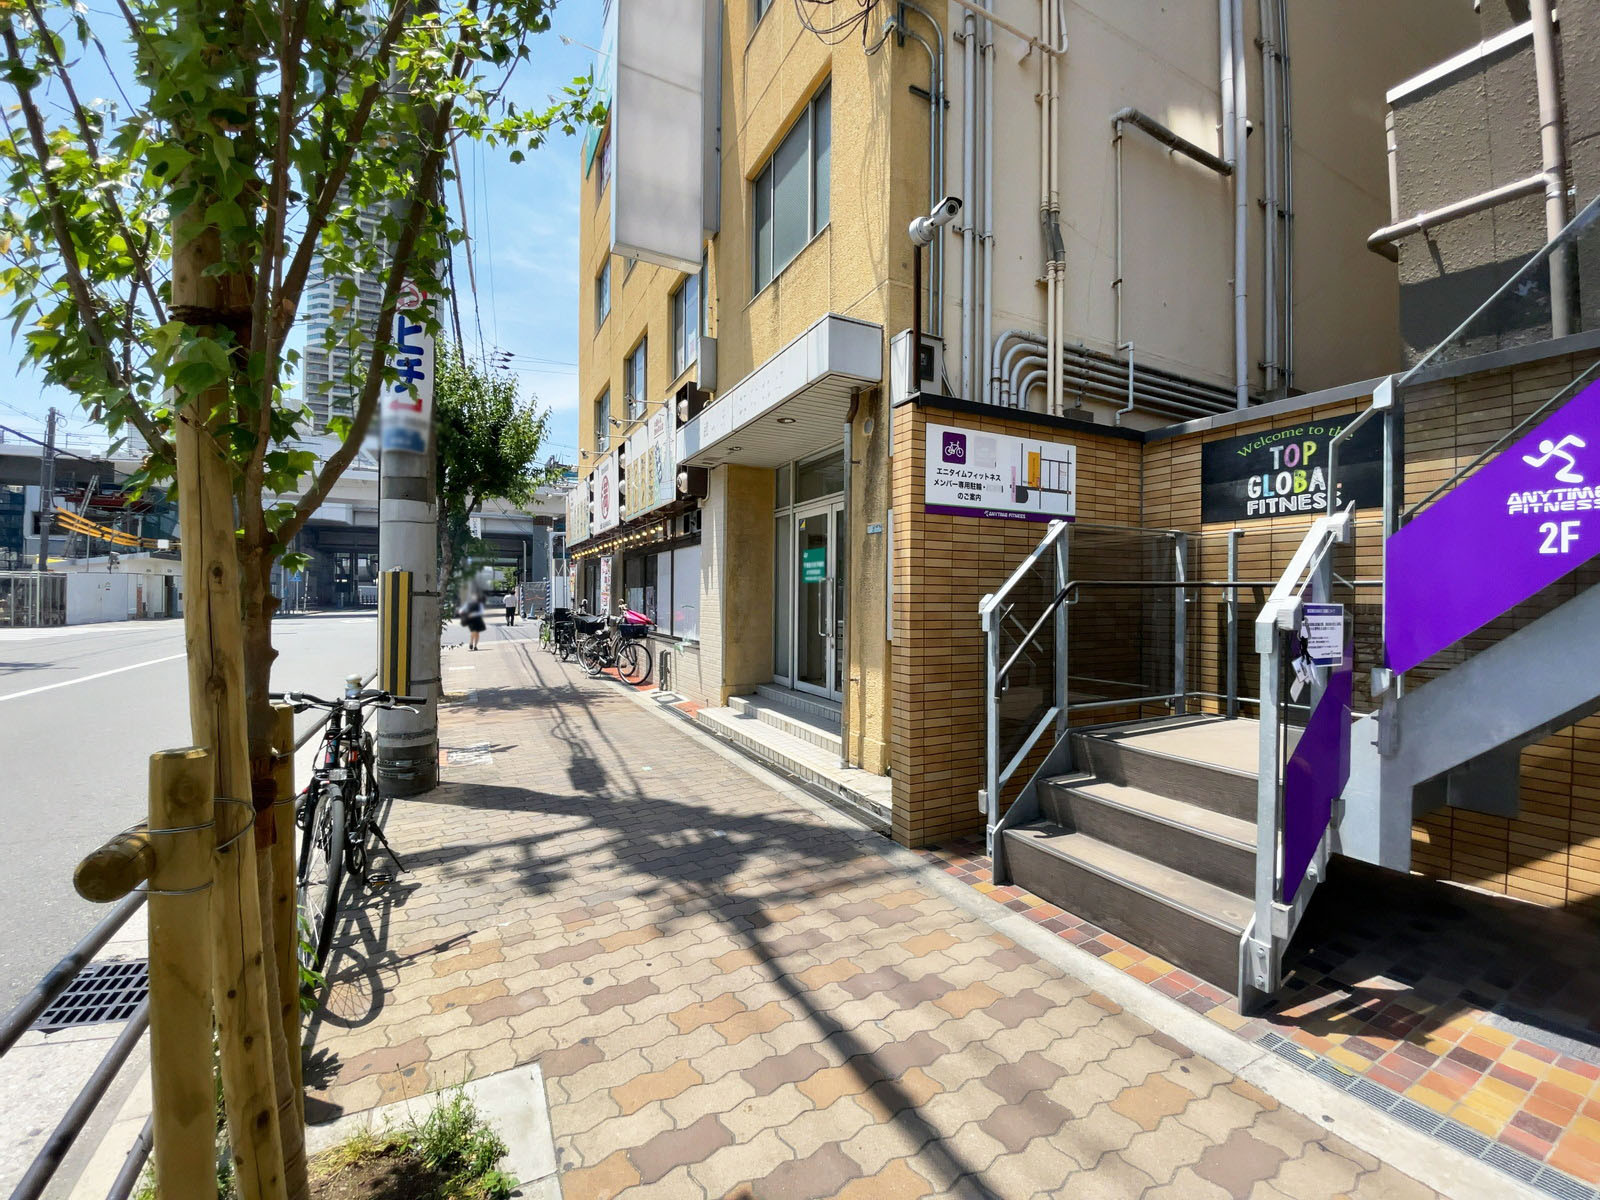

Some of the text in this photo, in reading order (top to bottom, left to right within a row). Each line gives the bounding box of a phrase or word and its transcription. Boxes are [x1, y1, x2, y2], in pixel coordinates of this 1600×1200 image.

[1237, 426, 1304, 457] Welcome
[1308, 426, 1324, 435] to
[1269, 441, 1317, 470] TOP
[936, 467, 1001, 482] エニタイムフィットネス
[1247, 466, 1342, 499] GLOBA
[957, 492, 982, 502] のご案内
[1539, 520, 1581, 554] 2F
